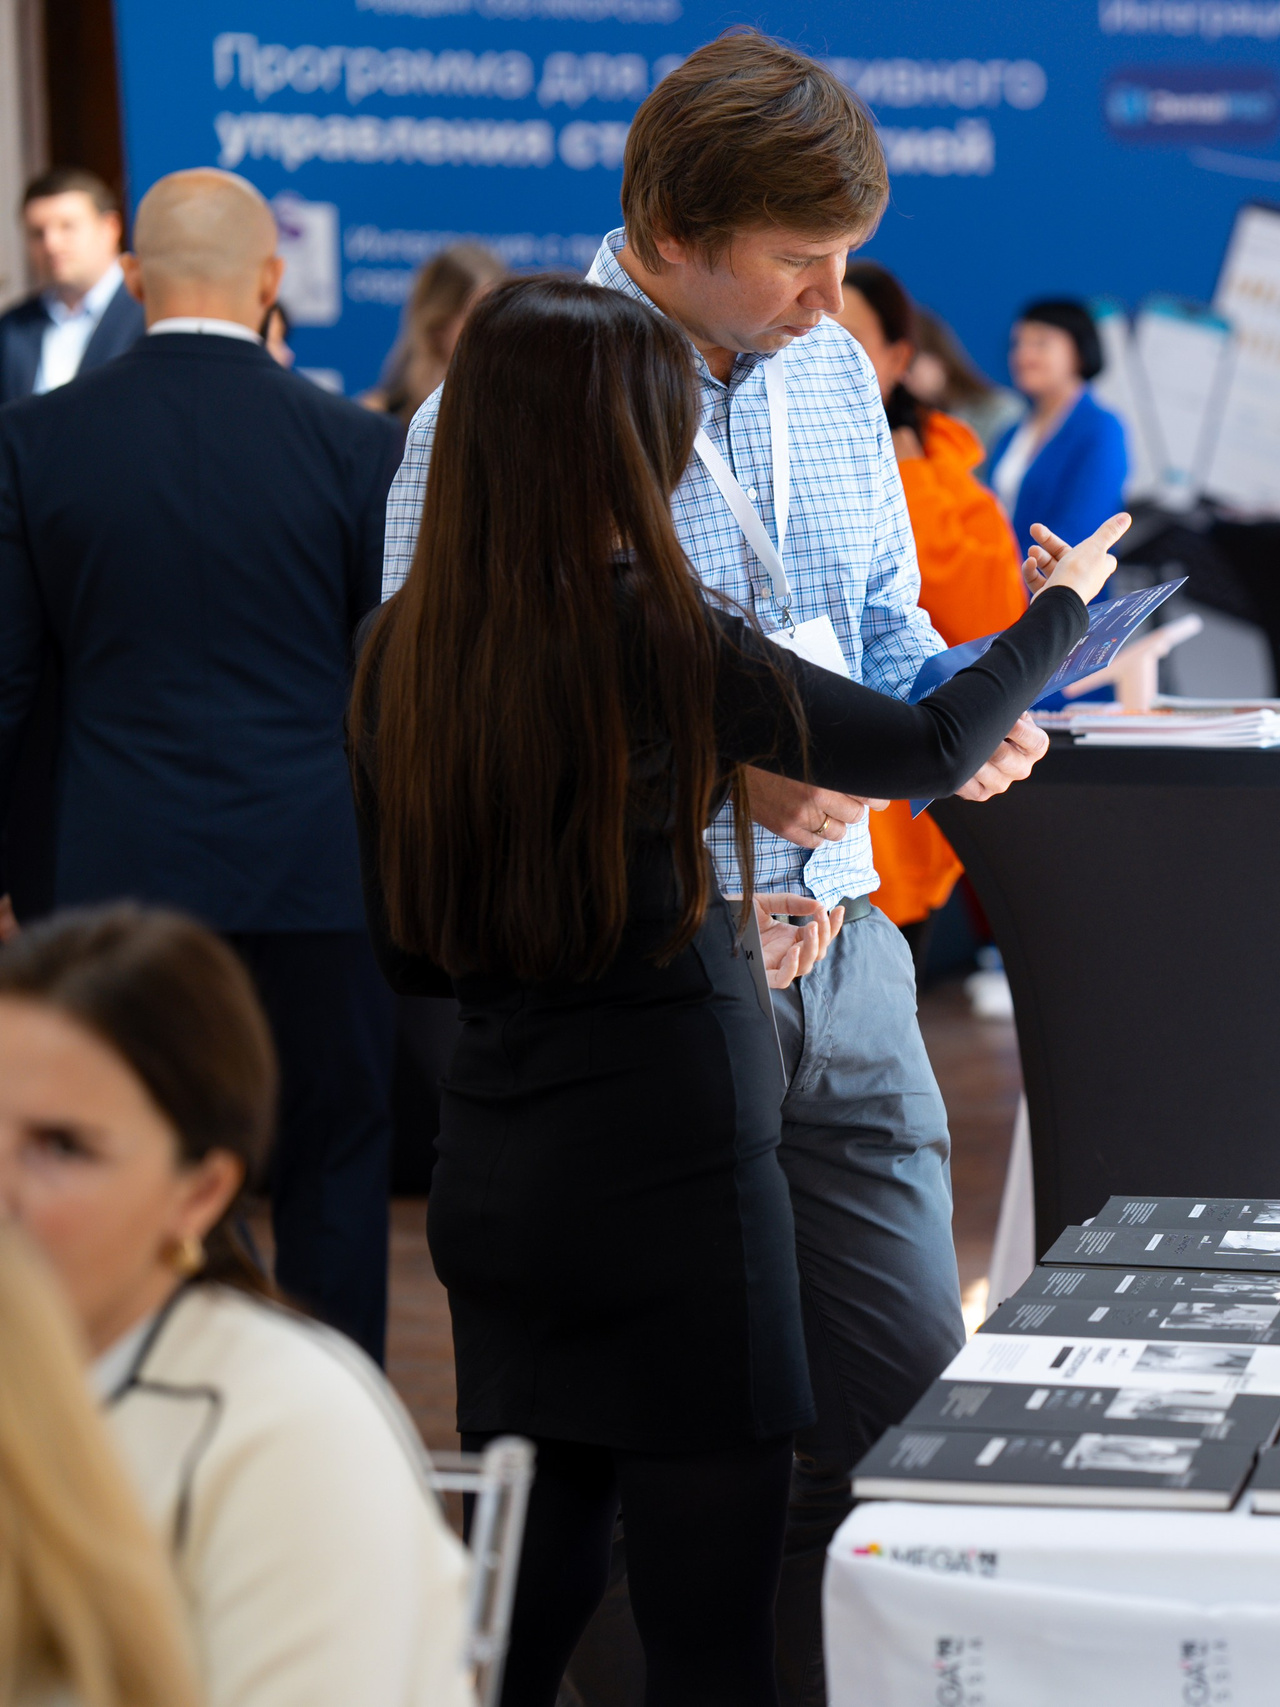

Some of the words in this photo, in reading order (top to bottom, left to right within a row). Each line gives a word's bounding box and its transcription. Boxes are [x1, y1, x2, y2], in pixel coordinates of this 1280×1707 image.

[214, 35, 532, 101] Программа
[540, 53, 647, 108] для
[215, 112, 552, 170] управления
